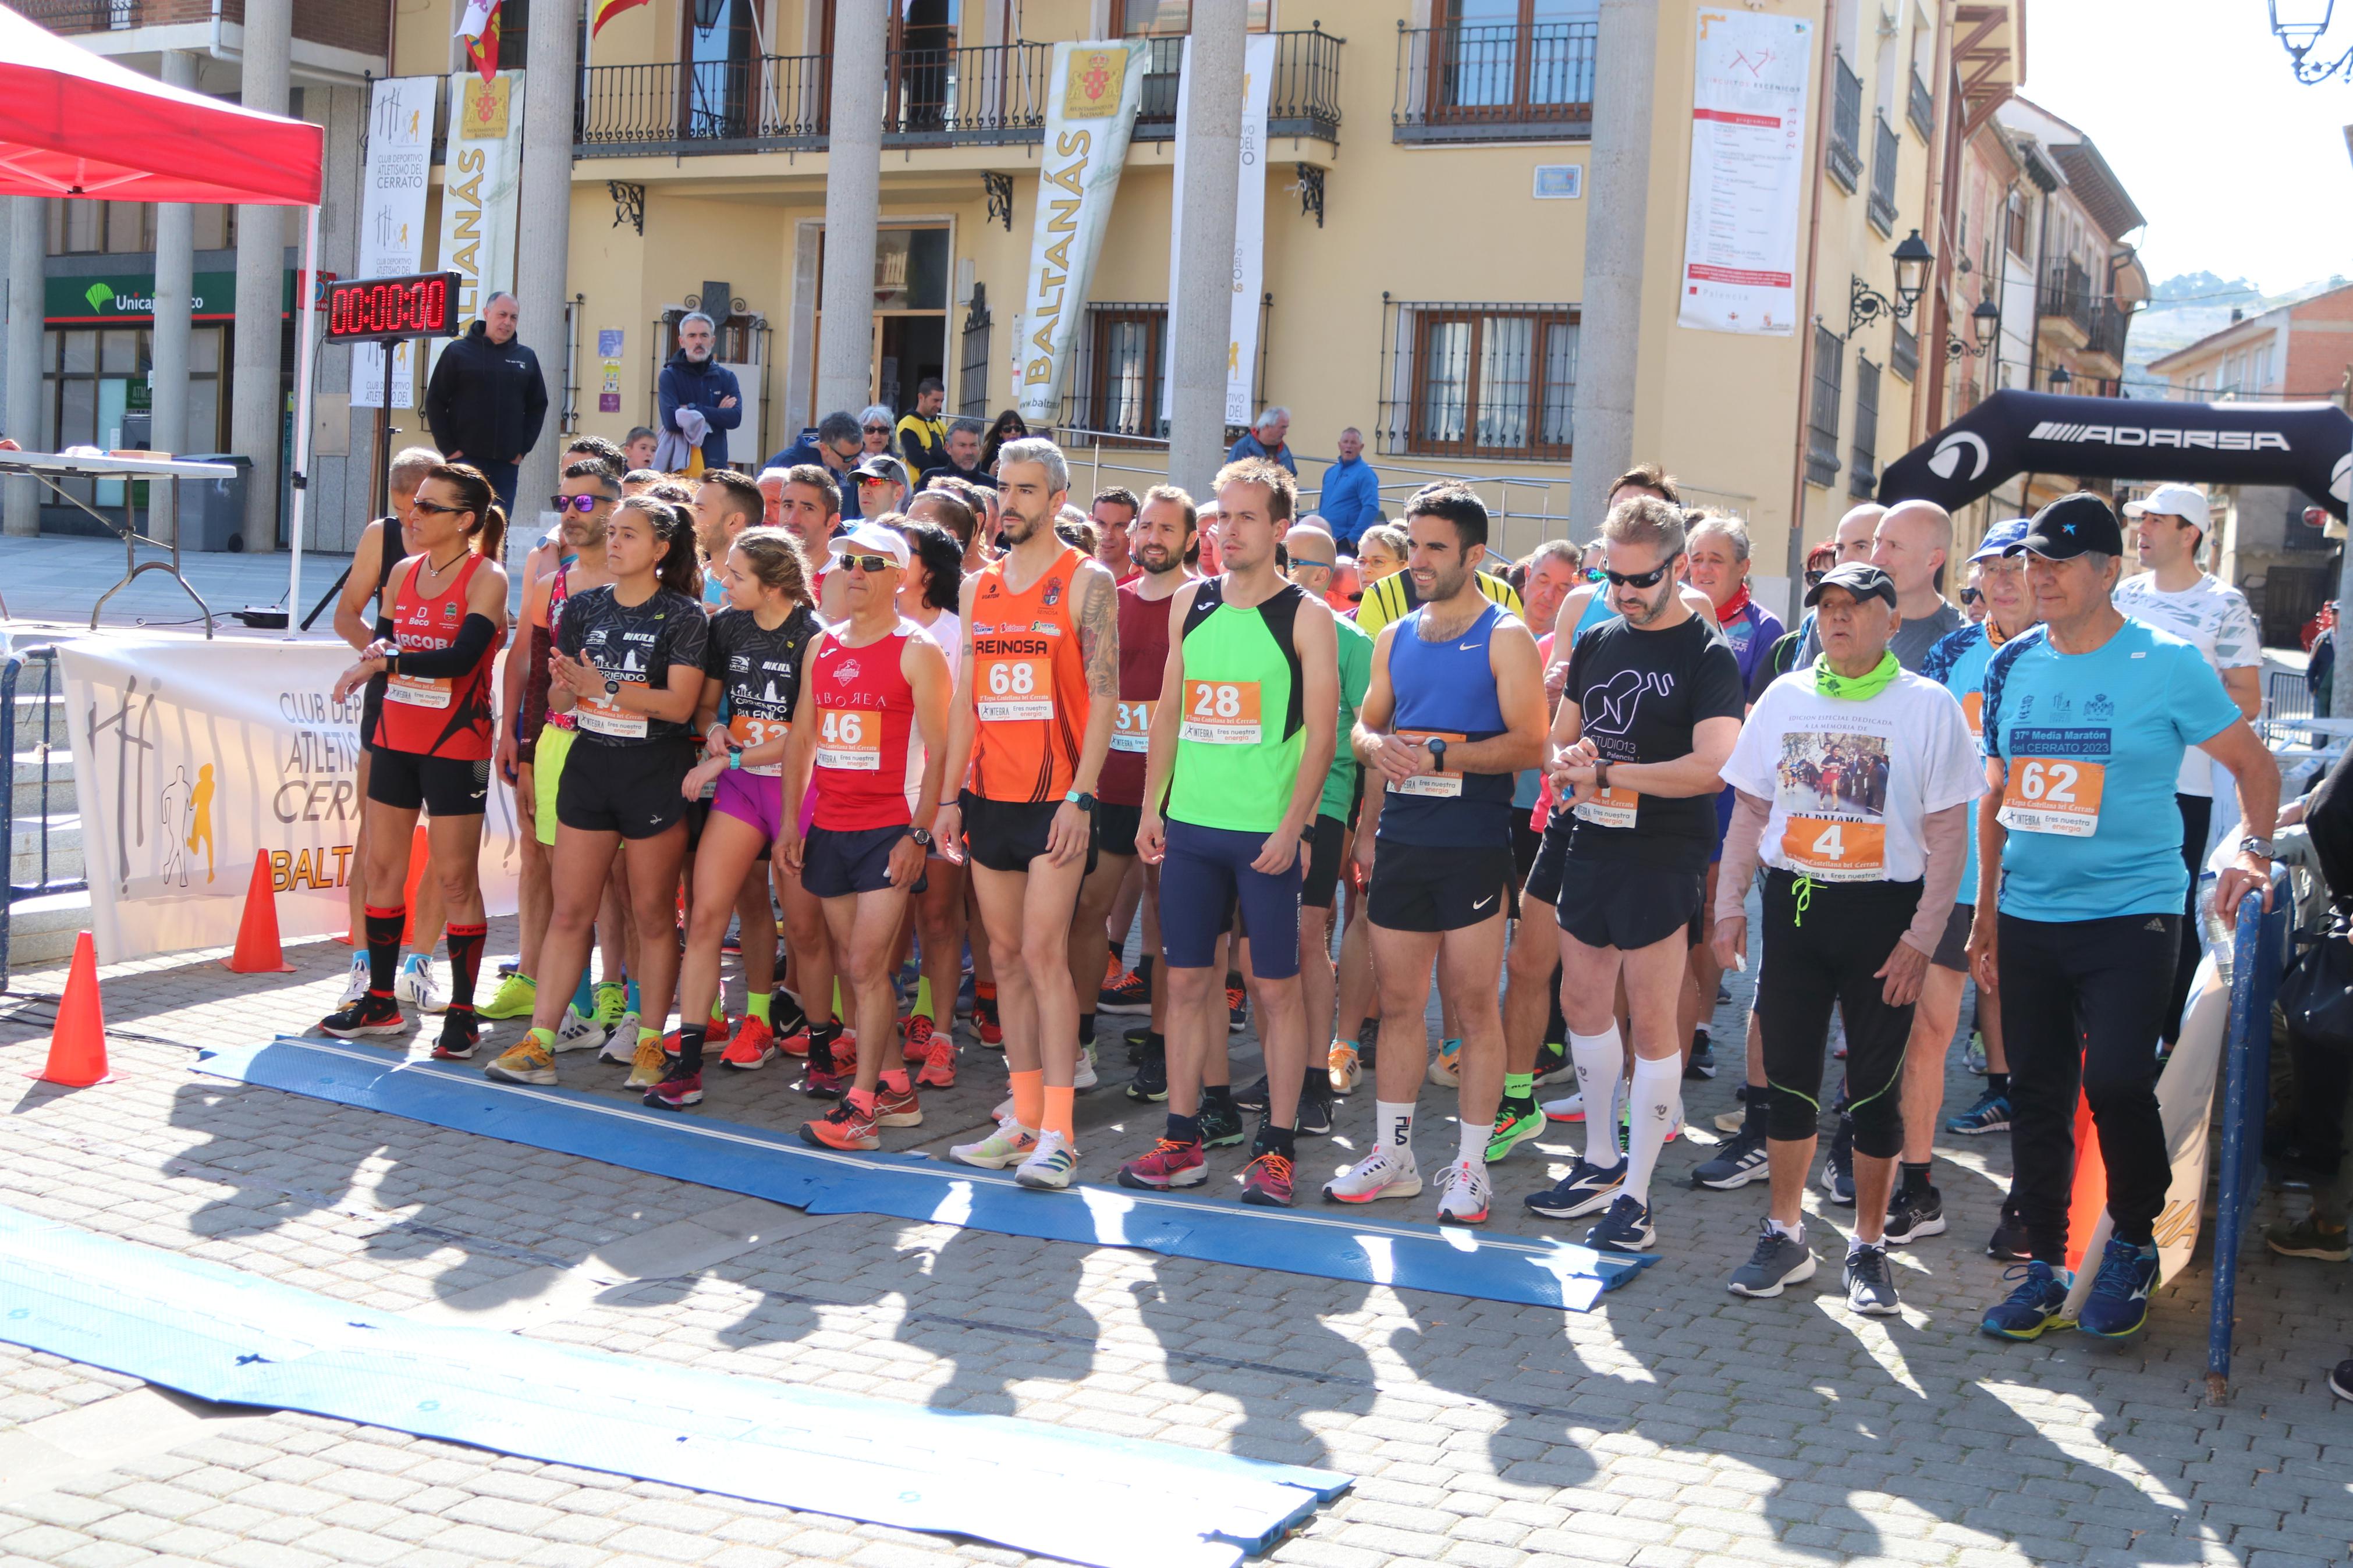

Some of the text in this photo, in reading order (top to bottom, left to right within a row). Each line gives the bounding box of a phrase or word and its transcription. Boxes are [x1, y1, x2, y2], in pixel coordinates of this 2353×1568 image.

[1786, 107, 1797, 150] 2023
[378, 154, 423, 163] CLUB DEPORTIVO
[378, 163, 422, 176] ATLETISMO DEL
[377, 176, 423, 189] CERRATO
[1024, 130, 1091, 386] BALTANÁS
[116, 291, 155, 313] Unicaj
[332, 280, 444, 334] 00:00:00
[2079, 426, 2291, 451] ADARSA
[409, 617, 430, 626] Beco
[393, 630, 456, 650] ÁRCOB
[623, 632, 655, 643] BIKILA
[975, 640, 1048, 656] REINOSA
[762, 661, 791, 673] BIKILA
[989, 662, 1034, 695] 68
[279, 692, 361, 724] CLUB DEP
[1194, 684, 1240, 717] 28
[989, 706, 1010, 716] INTEGRA
[1116, 703, 1148, 731] 31
[822, 713, 862, 744] 46
[1852, 716, 1893, 726] DEDICADA
[1194, 728, 1213, 738] INTEGRA
[2032, 731, 2061, 740] Media
[2065, 731, 2106, 739] Maratón
[285, 731, 361, 773] ATLETIS
[1591, 735, 1636, 754] STUDIO13
[2011, 744, 2109, 752] del CERRATO 2023
[1607, 752, 1634, 762] Palencia
[2021, 762, 2078, 803] 62
[273, 780, 361, 823] CER
[1610, 799, 1634, 808] Cerrato
[2027, 801, 2056, 809] Castellana
[2068, 803, 2095, 813] Cerrato
[2060, 817, 2090, 826] nuestra
[1812, 825, 1844, 861] 4
[271, 845, 353, 893] BALT
[1395, 1117, 1411, 1146] FILA
